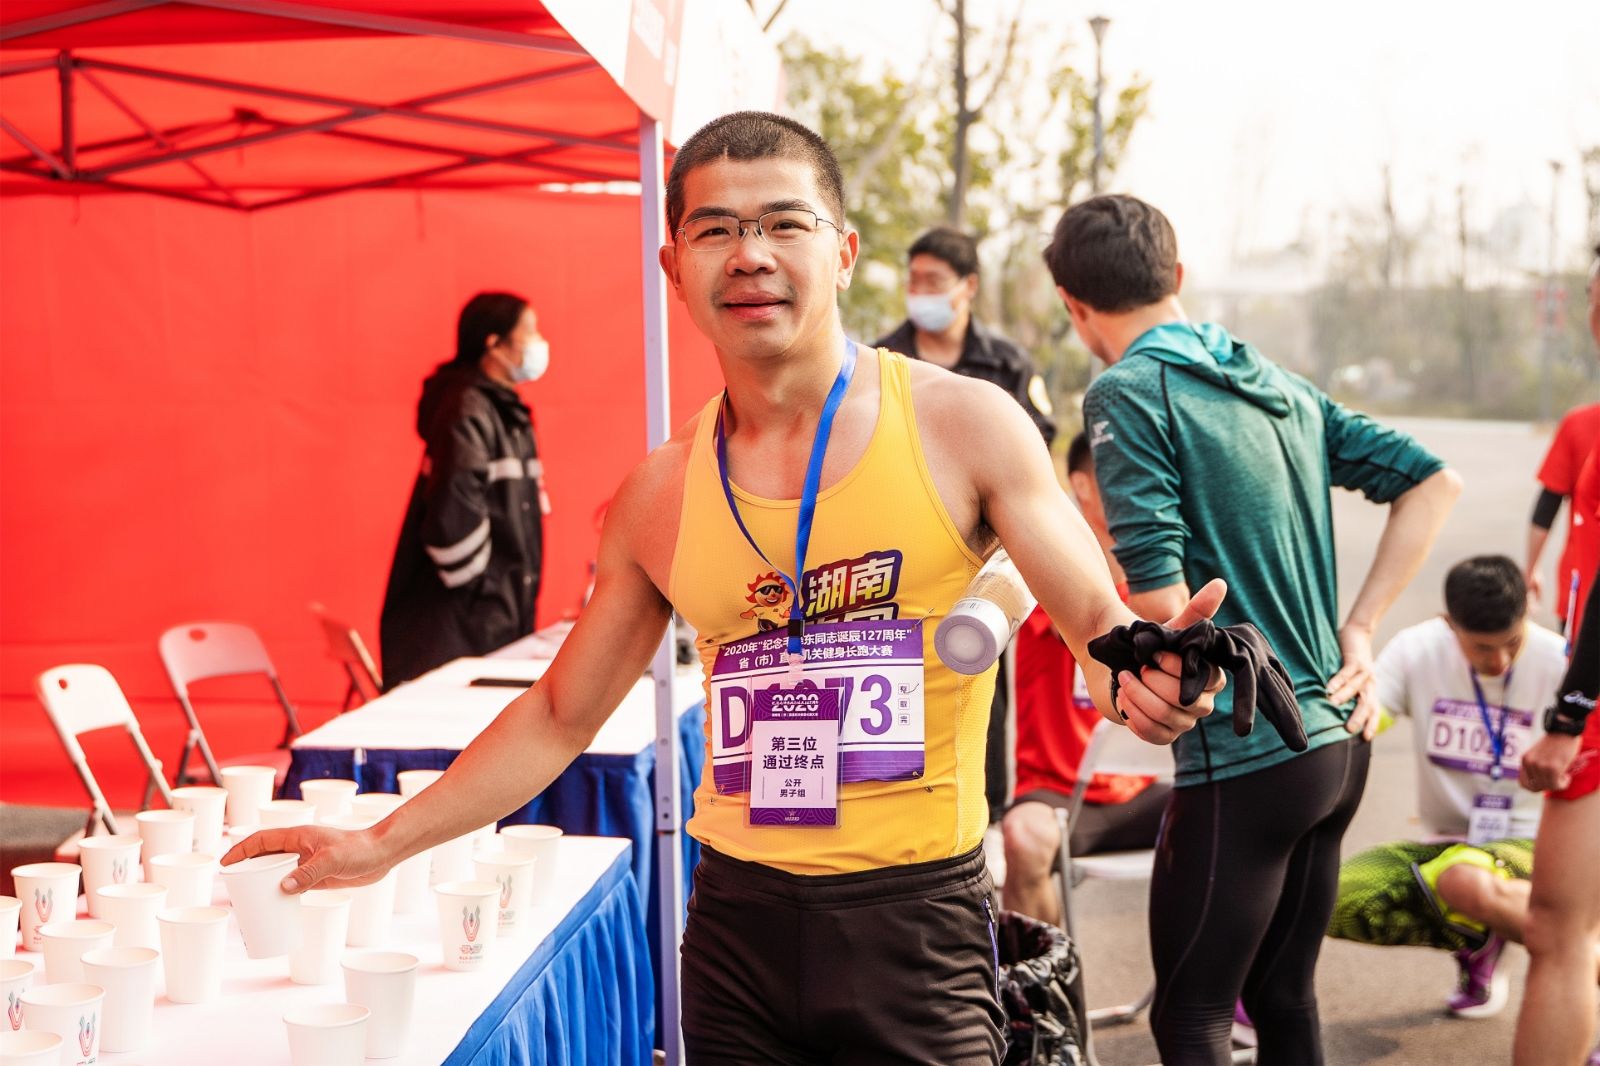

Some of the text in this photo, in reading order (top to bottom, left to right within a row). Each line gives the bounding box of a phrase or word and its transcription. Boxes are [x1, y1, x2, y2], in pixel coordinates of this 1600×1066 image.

[805, 556, 896, 617] 湖南
[771, 693, 819, 712] 2020
[719, 674, 893, 749] D73
[771, 736, 817, 752] 第三位
[763, 754, 825, 770] 通过终点
[784, 778, 802, 788] 公开
[780, 788, 806, 798] 男子组
